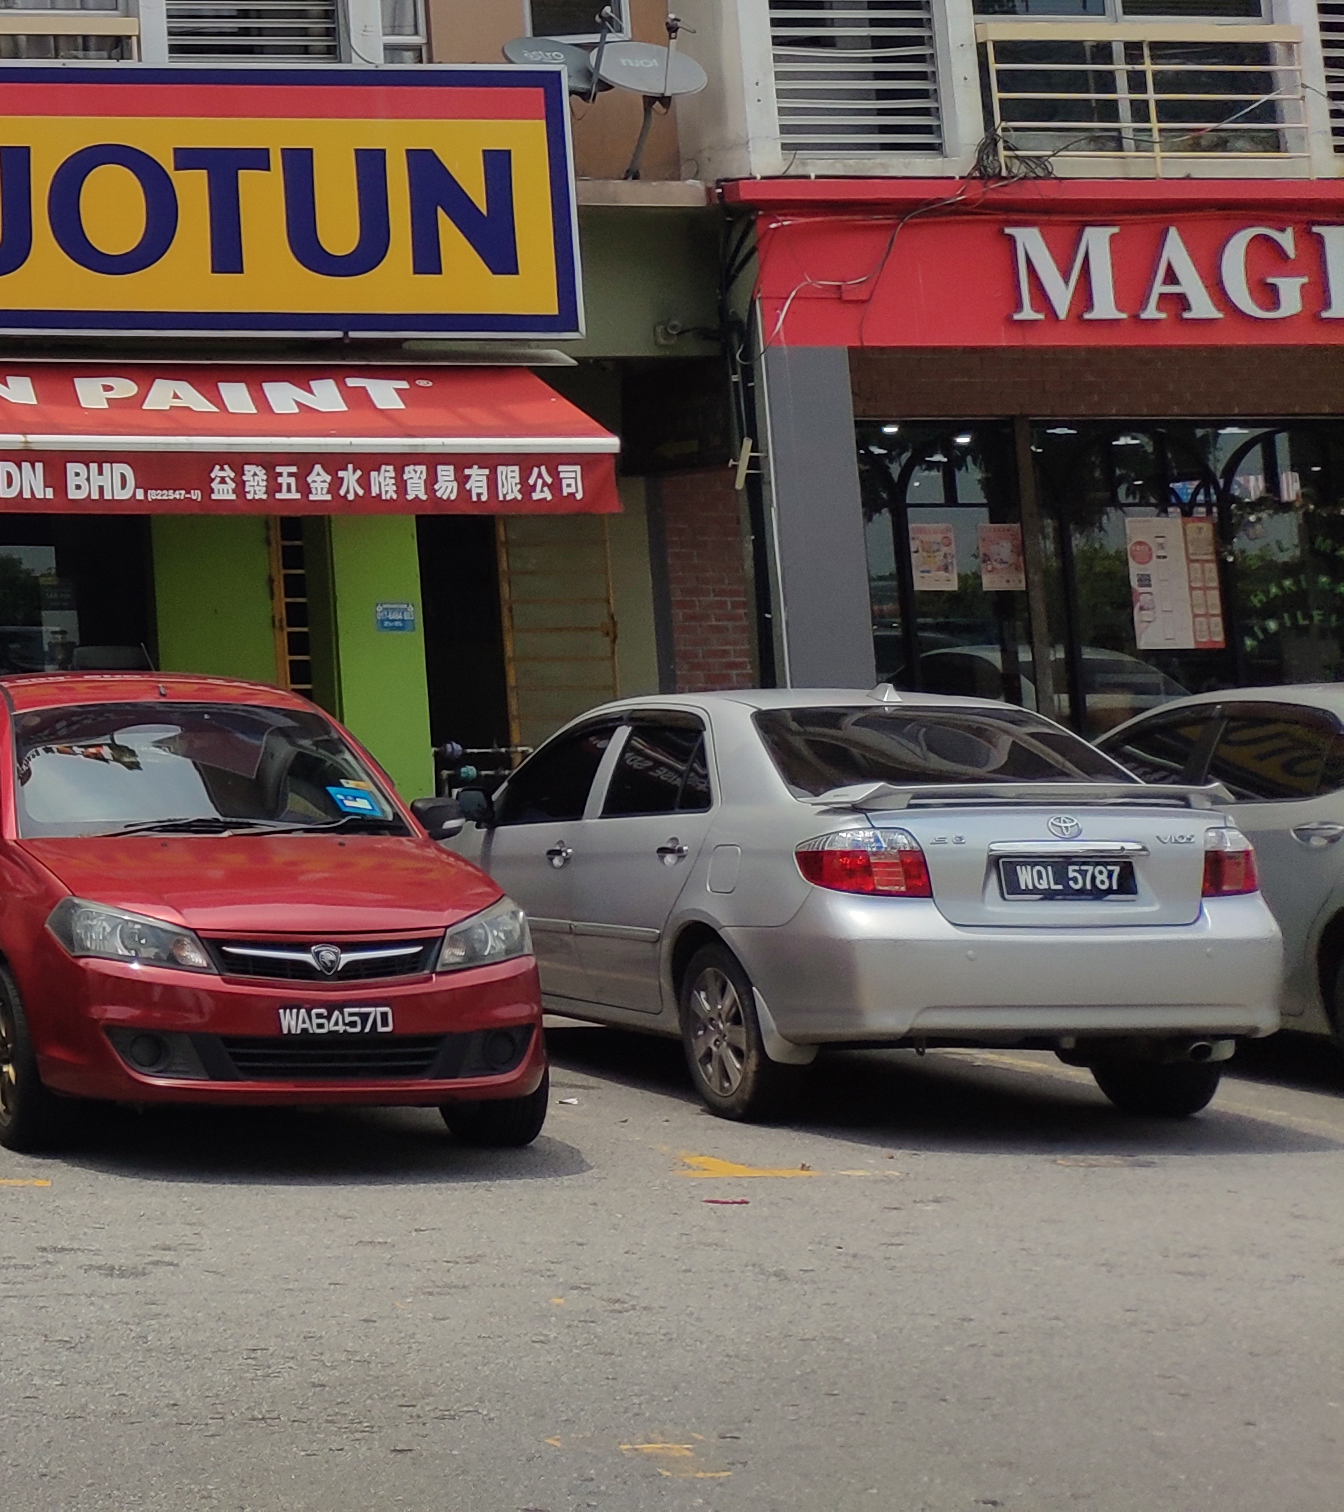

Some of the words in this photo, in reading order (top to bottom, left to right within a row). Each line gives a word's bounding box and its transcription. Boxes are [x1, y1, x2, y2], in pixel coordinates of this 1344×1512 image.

[72, 377, 411, 415] PAINT
[66, 462, 144, 501] BHD.
[1016, 865, 1063, 890] WQL
[1068, 865, 1120, 890] 5787
